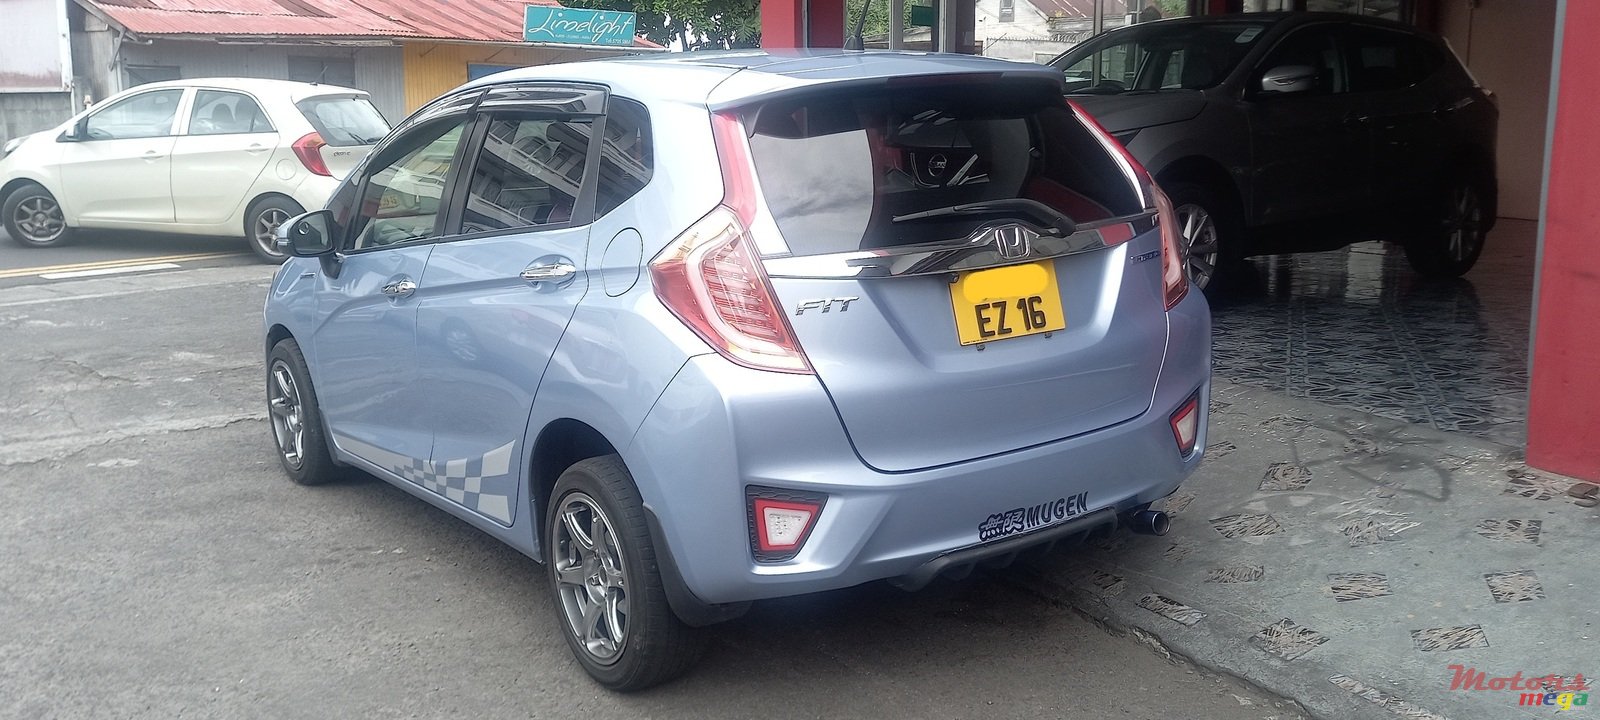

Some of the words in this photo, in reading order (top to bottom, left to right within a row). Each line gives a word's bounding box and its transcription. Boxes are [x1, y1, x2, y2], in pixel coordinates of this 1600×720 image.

[528, 9, 634, 43] Limelight
[796, 296, 860, 316] FIT
[974, 300, 1013, 338] EZ
[1016, 296, 1047, 332] 16
[1026, 491, 1089, 529] MUGEN
